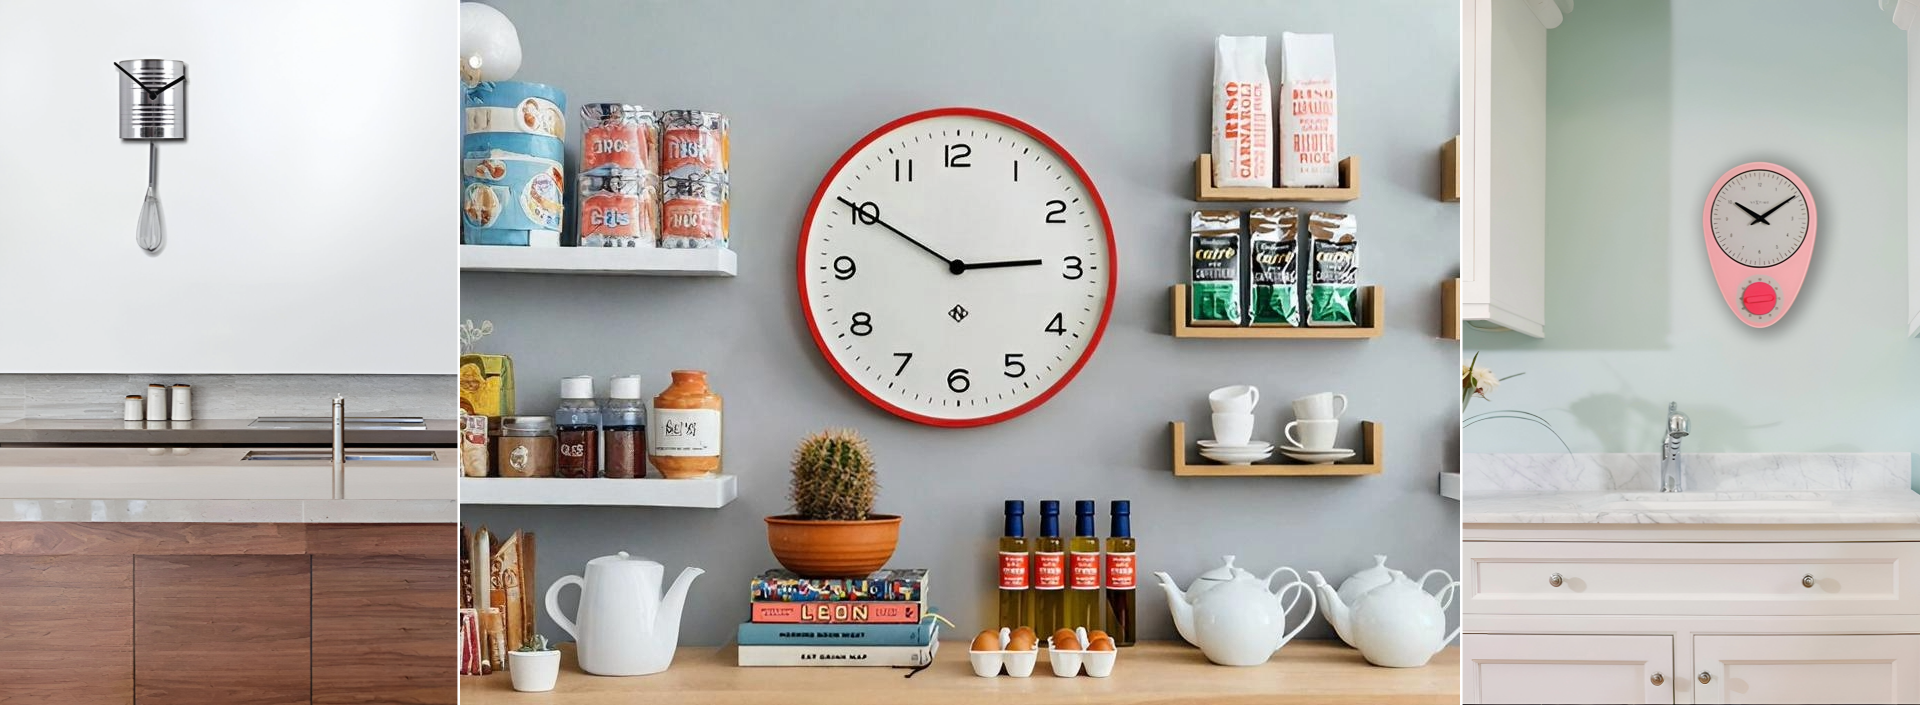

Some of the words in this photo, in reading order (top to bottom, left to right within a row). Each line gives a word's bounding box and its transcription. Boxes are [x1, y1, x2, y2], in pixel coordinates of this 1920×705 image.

[1225, 82, 1238, 138] RISO
[1240, 83, 1251, 178] CARNAROLI
[945, 144, 971, 167] 12
[1300, 153, 1330, 163] RICE
[895, 159, 913, 182] 11
[1013, 160, 1018, 182] 1
[852, 201, 880, 225] 10
[1046, 200, 1067, 223] 2
[834, 256, 856, 280] 9
[1063, 256, 1083, 280] 3
[850, 312, 873, 336] 8
[1045, 312, 1067, 336] 4
[893, 353, 913, 376] 7
[1004, 354, 1025, 378] 5
[947, 369, 970, 393] 6
[801, 603, 869, 621] LEON
